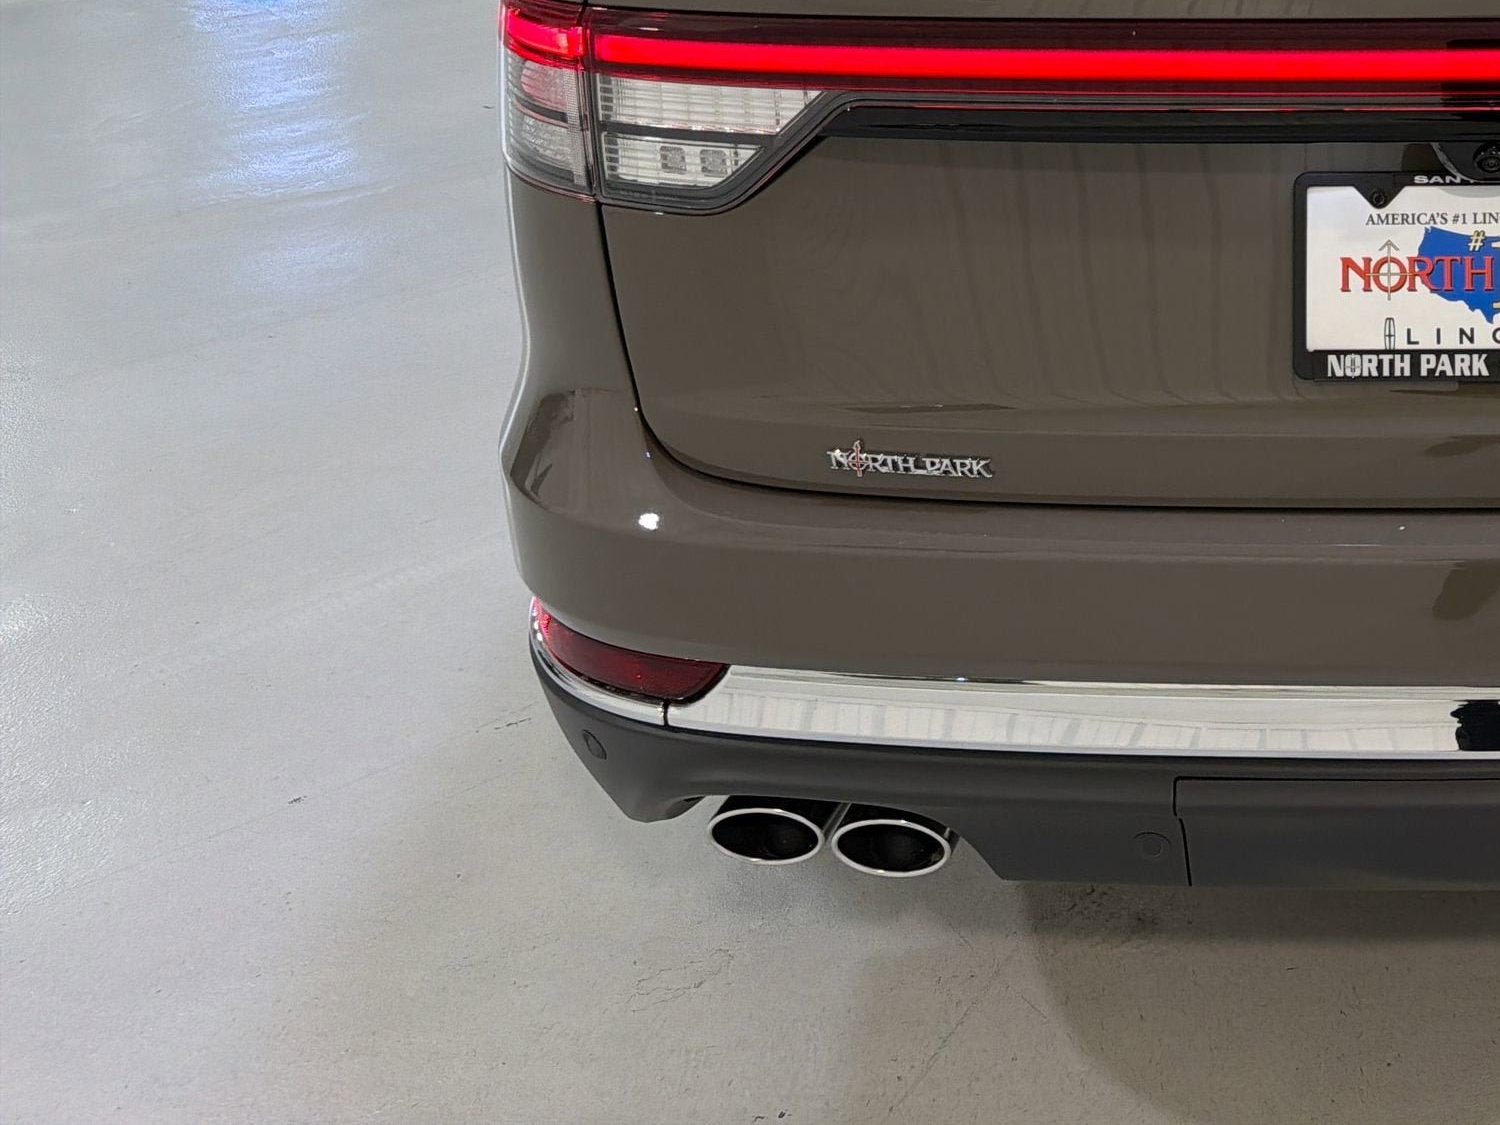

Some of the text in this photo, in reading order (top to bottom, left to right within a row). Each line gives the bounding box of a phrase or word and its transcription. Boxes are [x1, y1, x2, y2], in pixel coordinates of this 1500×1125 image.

[1413, 175, 1462, 184] SAN
[1365, 211, 1449, 225] AMERICA'S
[1452, 213, 1468, 225] #1
[1339, 255, 1496, 293] NORTH
[1327, 353, 1411, 378] NORTH
[1420, 353, 1490, 377] PARK
[827, 447, 993, 478] NORTH PARK
